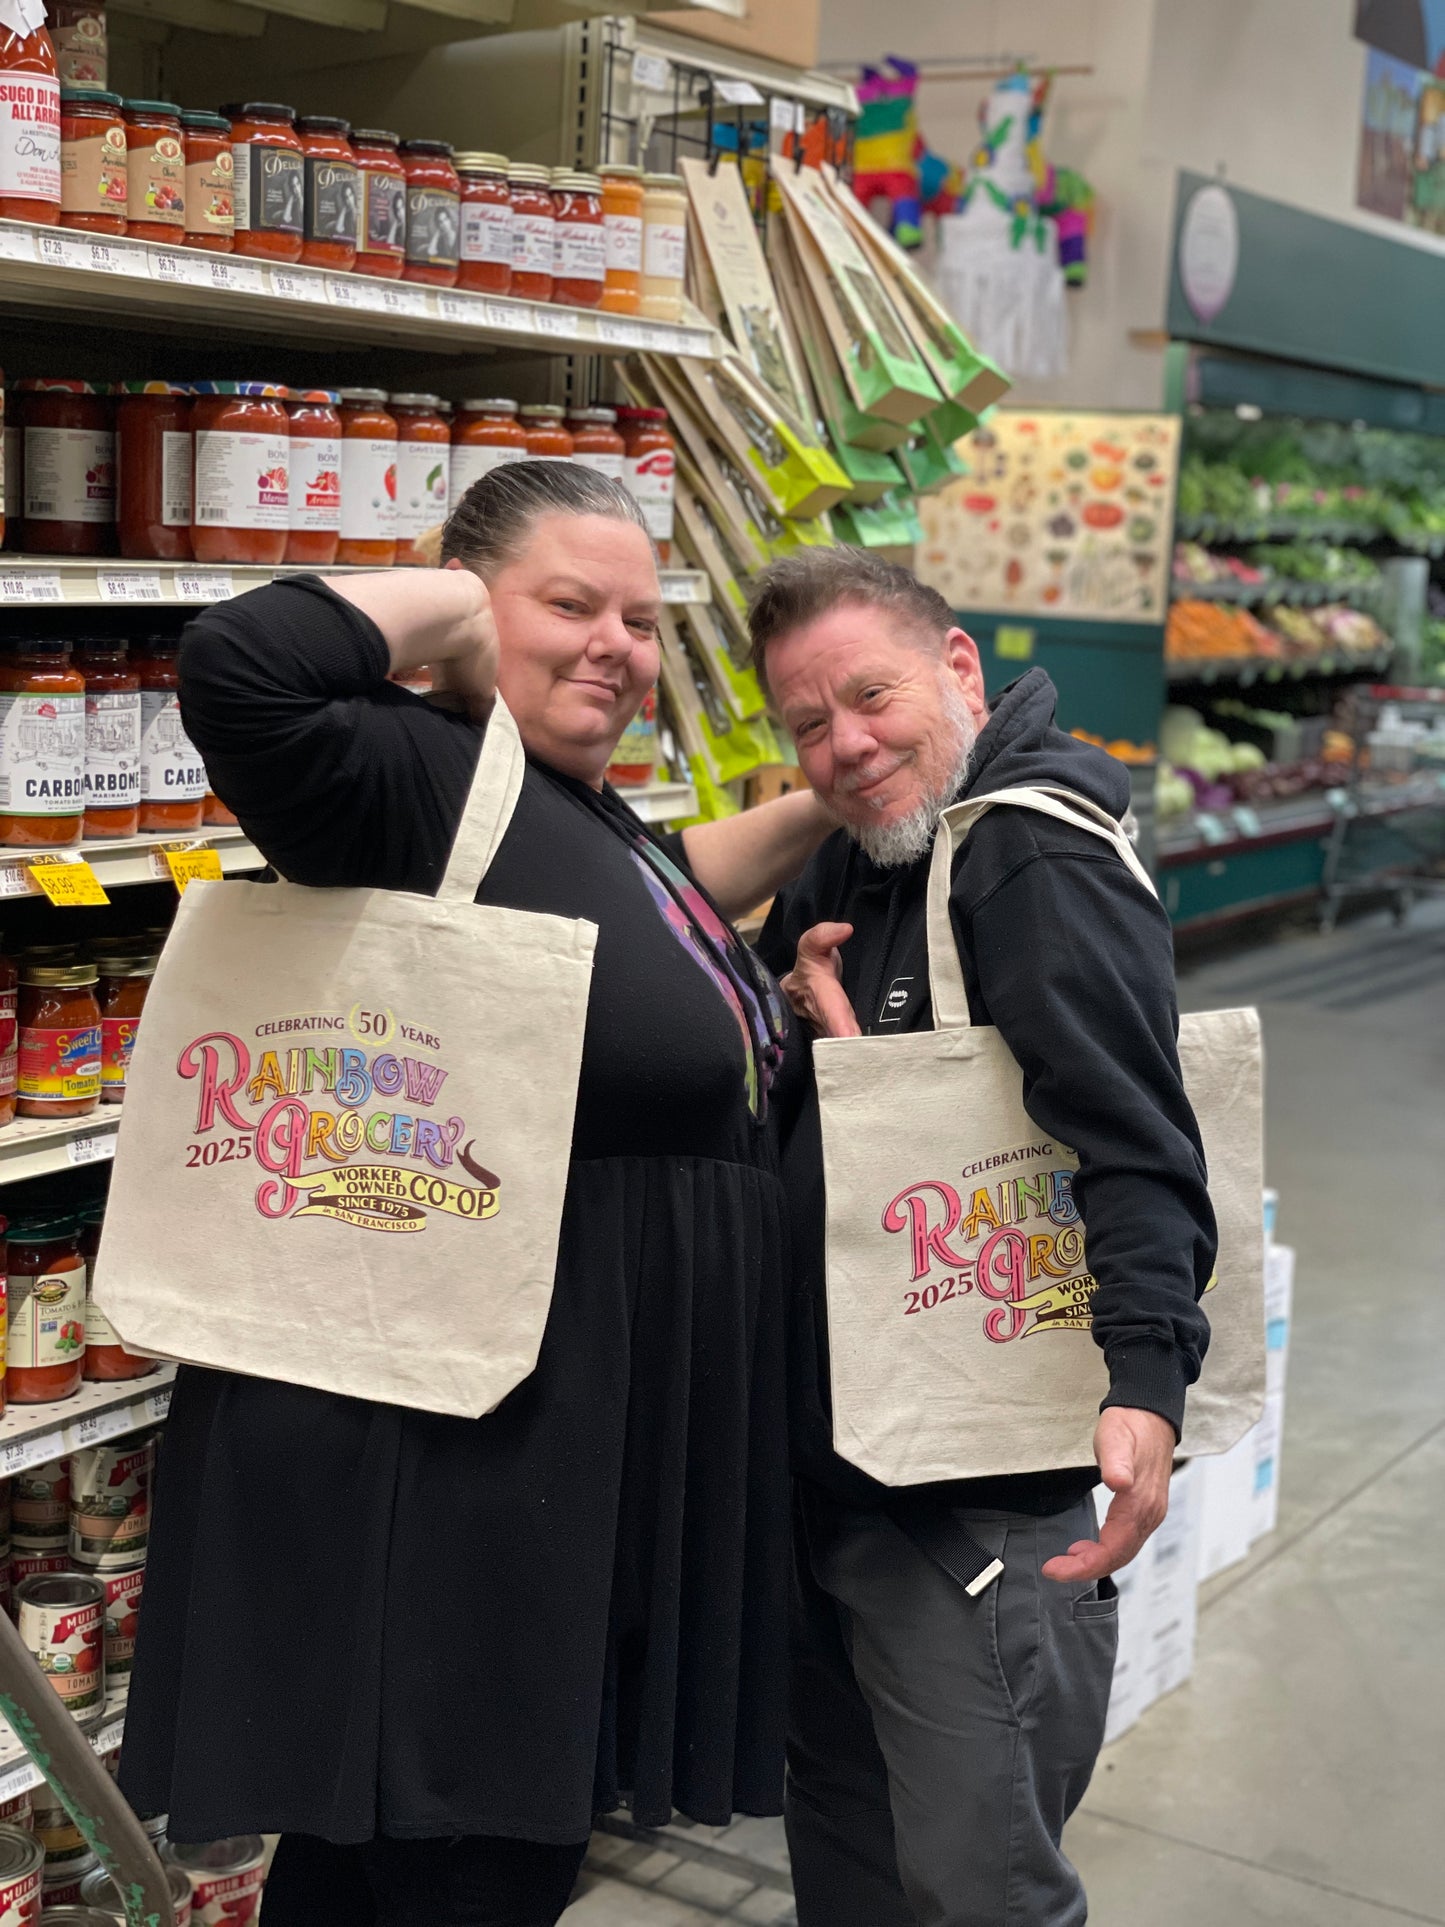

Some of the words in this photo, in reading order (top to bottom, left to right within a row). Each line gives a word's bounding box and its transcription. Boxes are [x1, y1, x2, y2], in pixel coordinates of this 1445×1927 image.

[0, 85, 34, 103] SUGO
[38, 88, 47, 106] DI
[41, 878, 75, 895] $8.99
[255, 1016, 345, 1038] CELEBRATING
[358, 1011, 387, 1036] 50
[401, 1025, 441, 1050] YEARS
[56, 1031, 94, 1057] Sweet
[65, 1078, 95, 1091] Tomato
[177, 1031, 449, 1134] RAINBOW
[185, 1136, 252, 1168] 2025
[255, 1097, 466, 1219] GROCERY
[962, 1143, 1053, 1179] CELEBRATING
[332, 1168, 402, 1183] WORKER
[337, 1196, 376, 1210] SINCE
[380, 1201, 410, 1217] 1975
[346, 1181, 407, 1197] OWNED
[410, 1175, 496, 1217] CO-OP
[334, 1209, 355, 1222] SAN
[357, 1216, 417, 1230] FRANCISCO
[903, 1272, 974, 1316] 2025
[41, 1304, 72, 1316] TOMATO
[19, 1561, 49, 1574] MUIR
[112, 1574, 142, 1594] MUIR
[67, 1608, 97, 1630] MUIR
[3, 1877, 34, 1905] MUIR
[204, 1878, 240, 1897] MUIR
